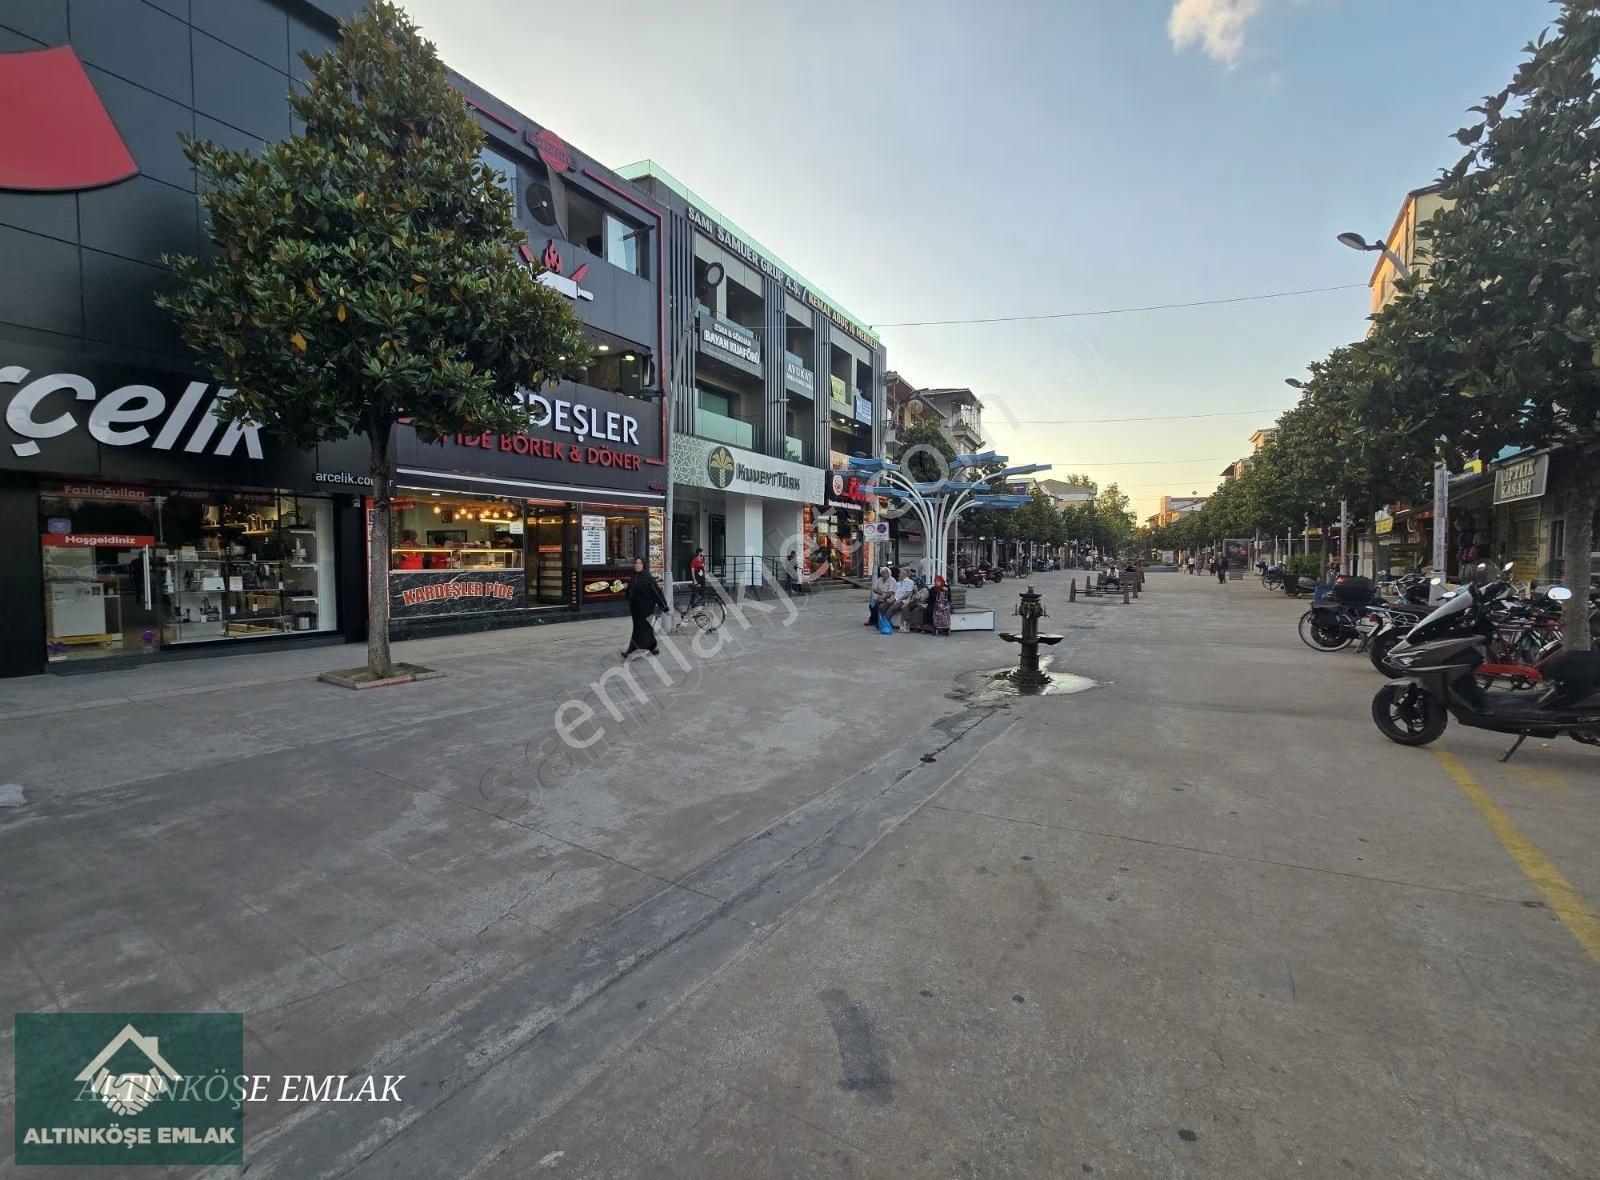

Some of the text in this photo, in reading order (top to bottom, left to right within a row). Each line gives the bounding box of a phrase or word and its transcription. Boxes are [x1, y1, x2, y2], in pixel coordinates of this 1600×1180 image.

[717, 226, 759, 266] SAMUER
[760, 259, 784, 282] GRUP
[808, 293, 831, 317] KEMAL
[703, 329, 729, 350] BAYAN
[501, 432, 565, 461] BÖREK
[569, 444, 583, 463] &
[587, 445, 641, 471] DÖNER
[65, 535, 136, 547] Hoşgeldiniz
[402, 580, 515, 606] KARDEŞLER PİDE
